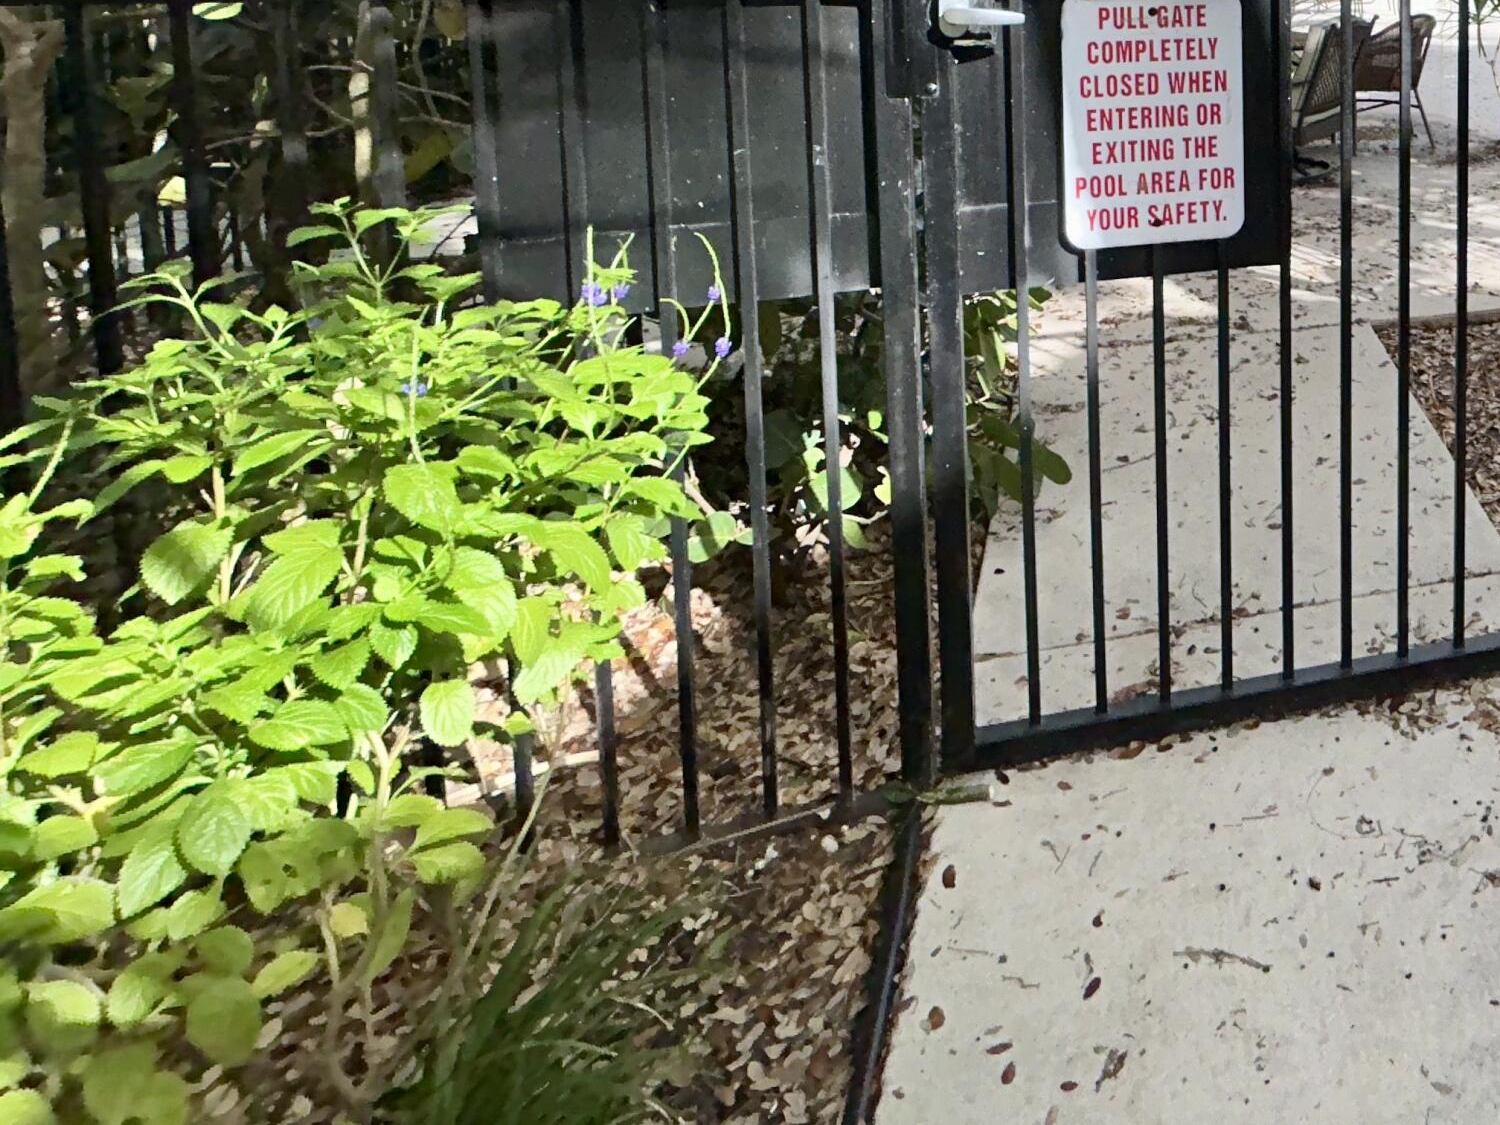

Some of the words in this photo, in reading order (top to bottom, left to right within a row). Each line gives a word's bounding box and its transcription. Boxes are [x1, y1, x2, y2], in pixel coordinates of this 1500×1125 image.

[1098, 6, 1149, 30] PULL
[1156, 4, 1207, 28] GATE
[1087, 37, 1218, 64] COMPLETELY
[1079, 73, 1160, 99] CLOSED
[1167, 70, 1228, 94] WHEN
[1086, 104, 1189, 132] ENTERING
[1196, 103, 1222, 126] OR
[1092, 138, 1174, 165] EXITING
[1182, 135, 1218, 159] THE
[1075, 174, 1127, 199] POOL
[1136, 170, 1191, 195] AREA
[1198, 167, 1235, 191] FOR
[1086, 206, 1139, 231] YOUR
[1147, 199, 1228, 226] SAFETY.
